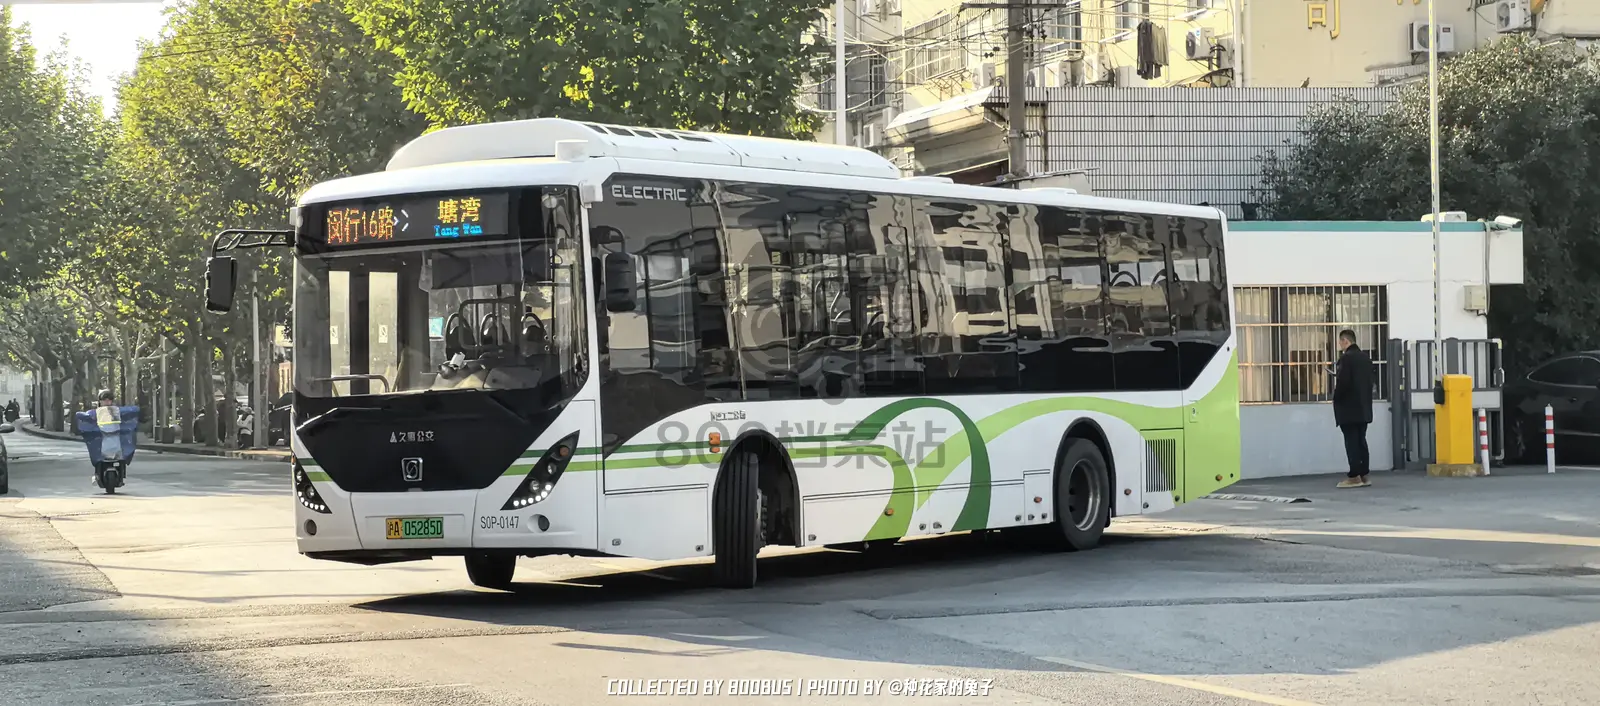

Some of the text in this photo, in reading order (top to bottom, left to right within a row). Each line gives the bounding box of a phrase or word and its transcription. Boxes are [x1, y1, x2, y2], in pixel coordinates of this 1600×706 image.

[611, 184, 688, 201] ELECTRIC
[438, 196, 481, 223] 塘湾
[326, 205, 394, 244] 闵行16路
